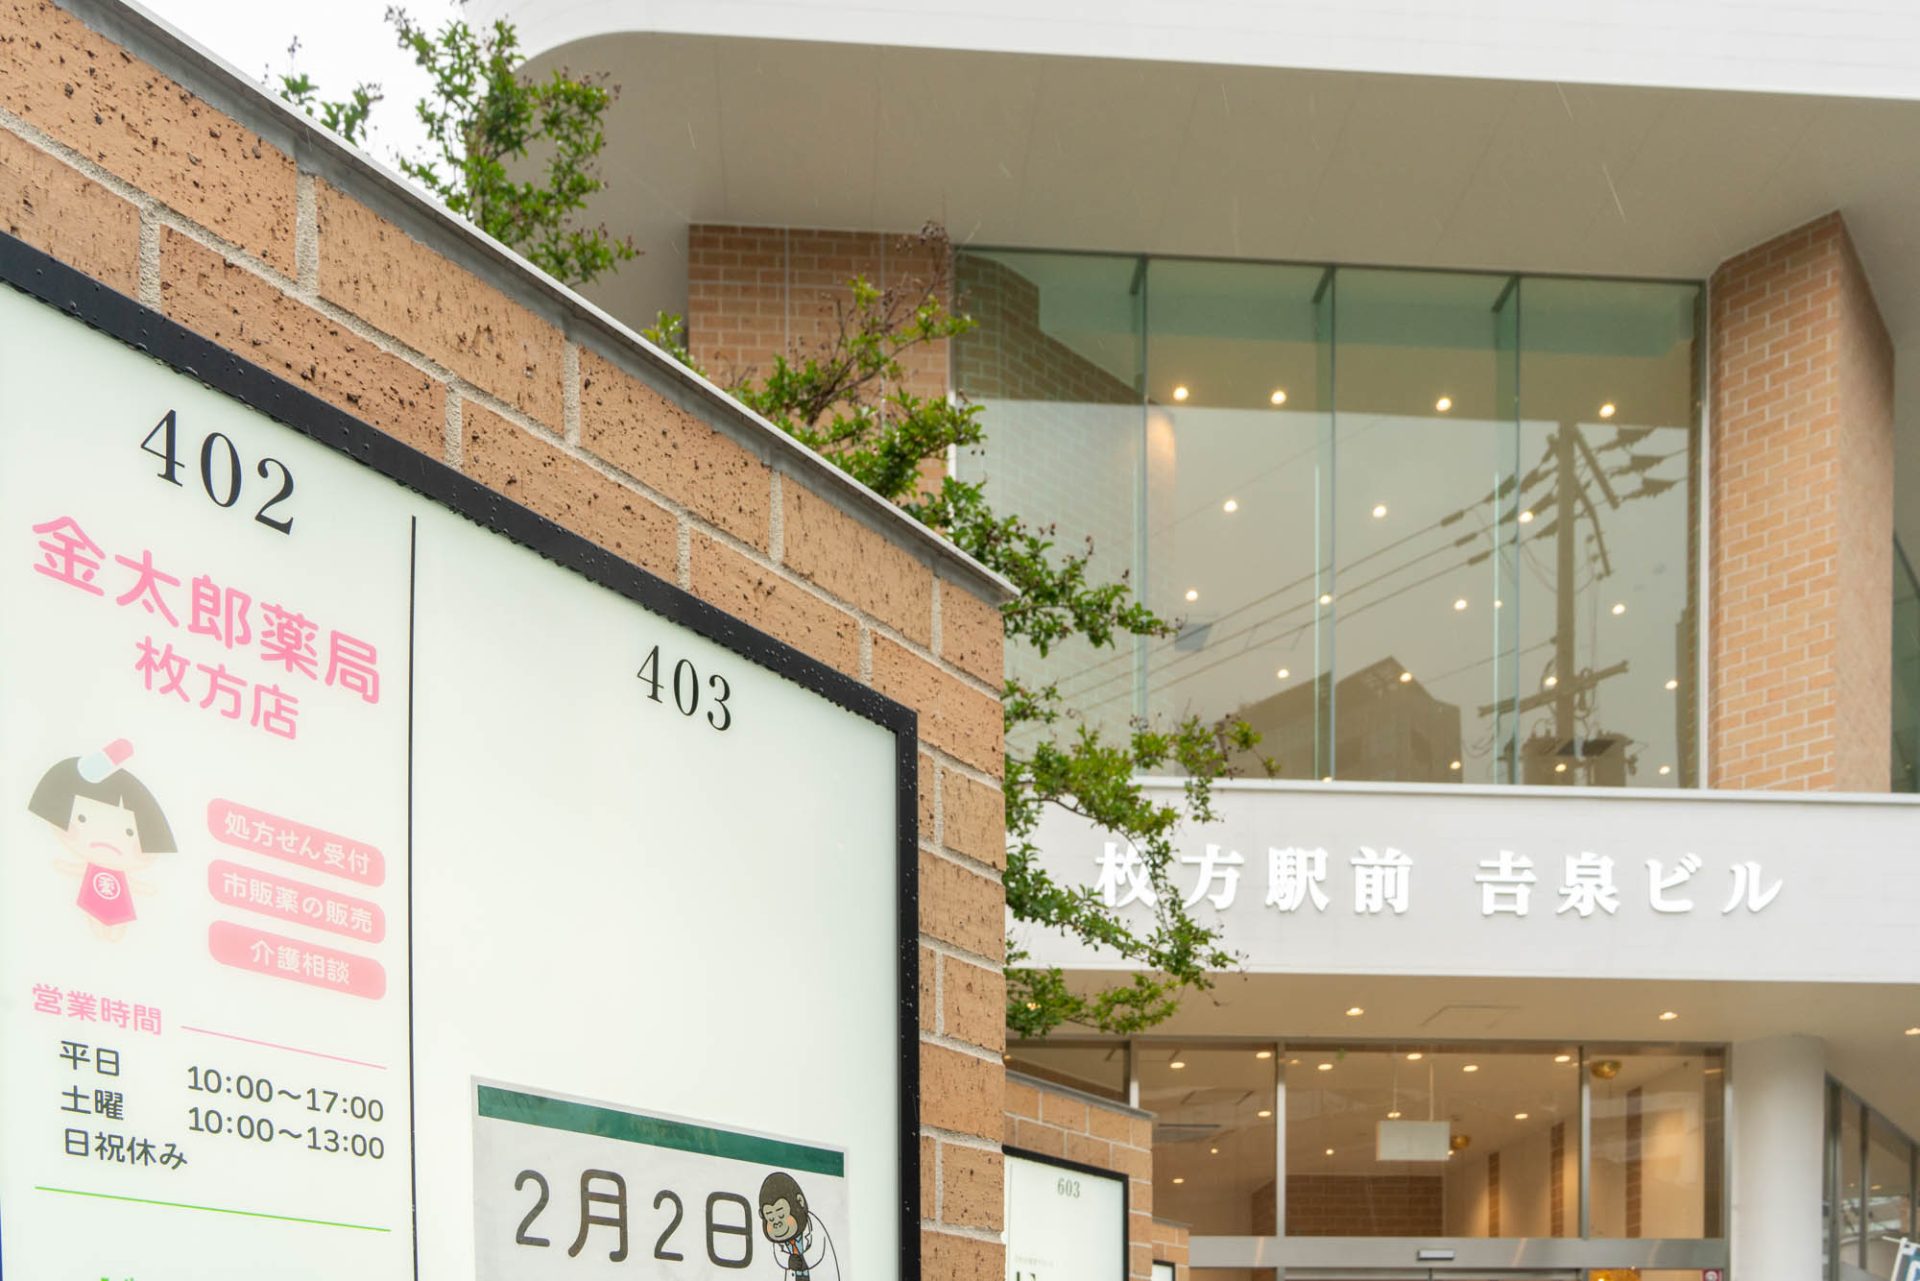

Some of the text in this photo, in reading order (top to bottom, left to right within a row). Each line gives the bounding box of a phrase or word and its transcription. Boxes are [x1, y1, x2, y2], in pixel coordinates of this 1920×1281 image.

[140, 409, 295, 535] 402
[31, 516, 380, 704] 金太郎薬局
[135, 635, 300, 740] 枚方店
[636, 644, 732, 732] 403
[224, 811, 372, 876] 処方せん受付
[222, 872, 374, 934] 市販薬の販売
[1094, 841, 1415, 915] 枚方駅前
[249, 939, 351, 985] 介護相談
[32, 983, 163, 1036] 営業時間
[59, 1040, 121, 1077] 平日
[60, 1085, 125, 1121] 土曜
[64, 1127, 188, 1170] 日祝休み
[514, 1169, 753, 1269] 2月2日
[1057, 1178, 1080, 1199] 603
